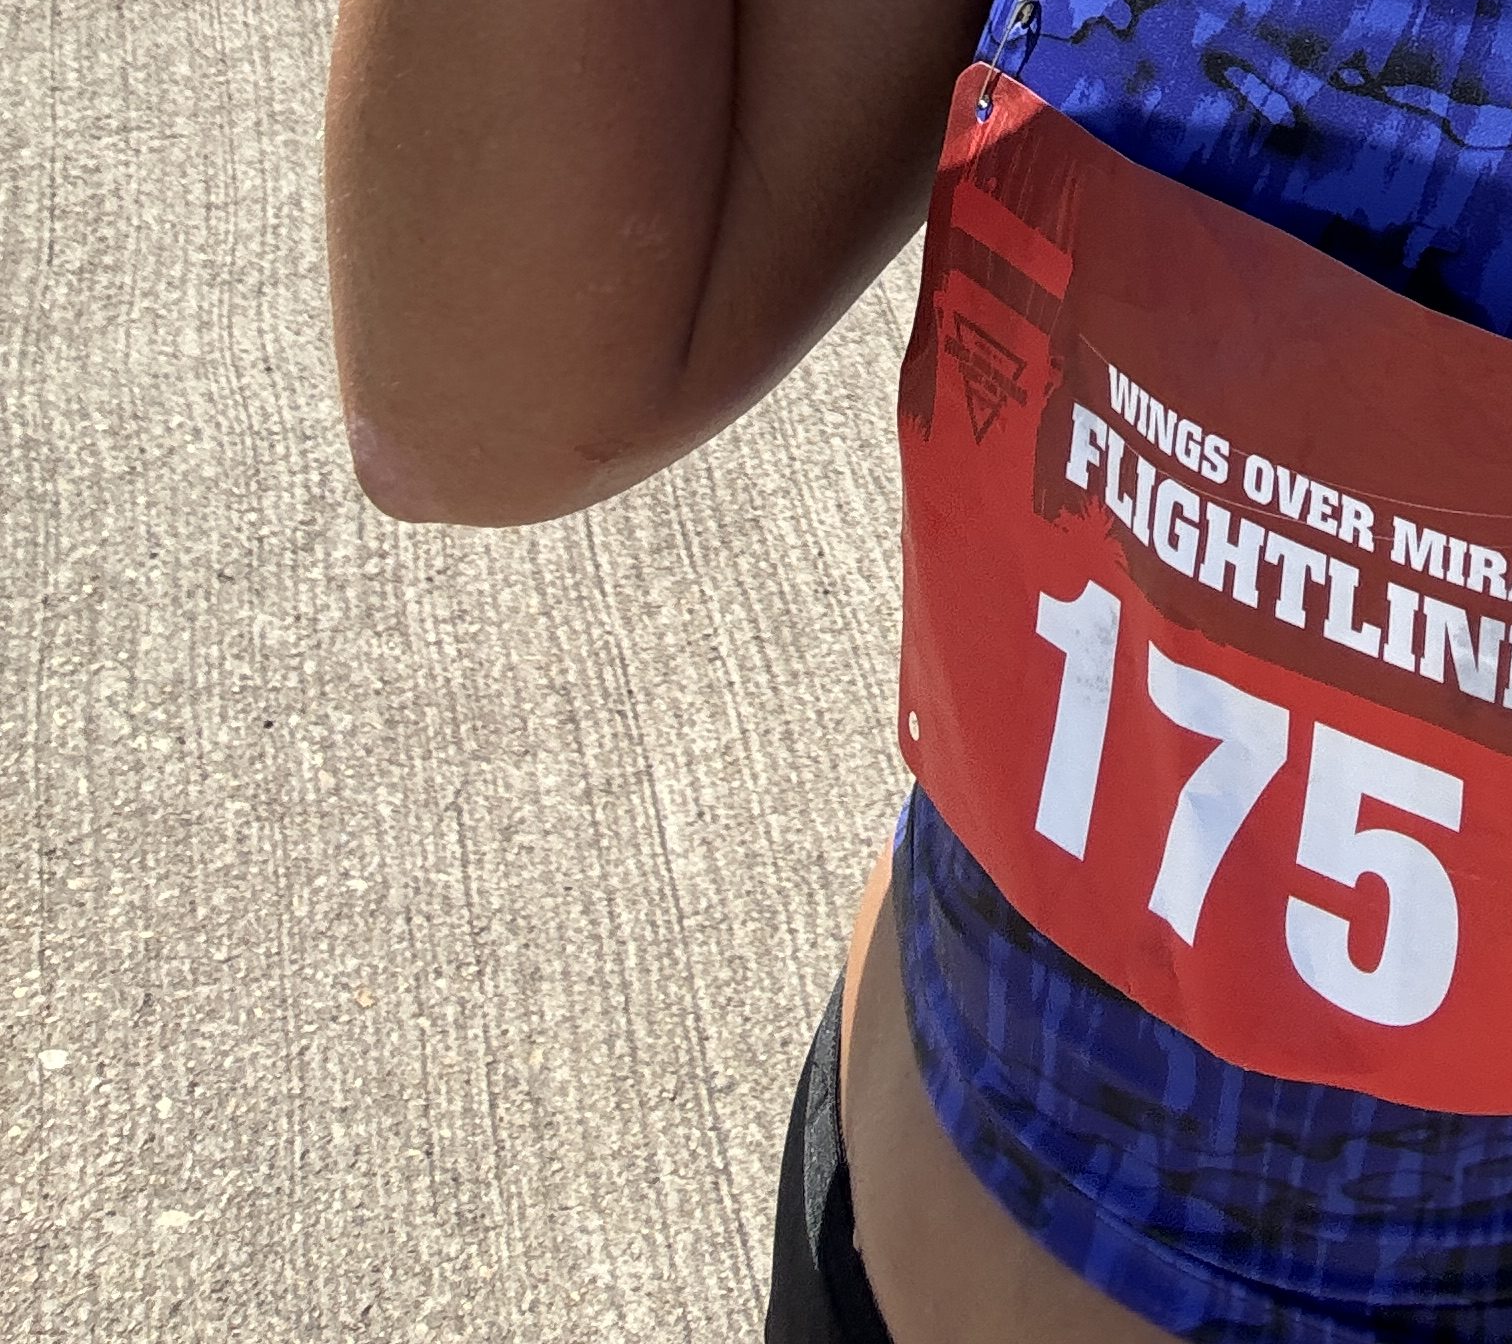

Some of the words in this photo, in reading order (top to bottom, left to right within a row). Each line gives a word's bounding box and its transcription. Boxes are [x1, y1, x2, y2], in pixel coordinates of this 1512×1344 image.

[1107, 362, 1231, 485] WINGS
[1243, 453, 1376, 554] OVER
[1033, 578, 1465, 1028] 175
